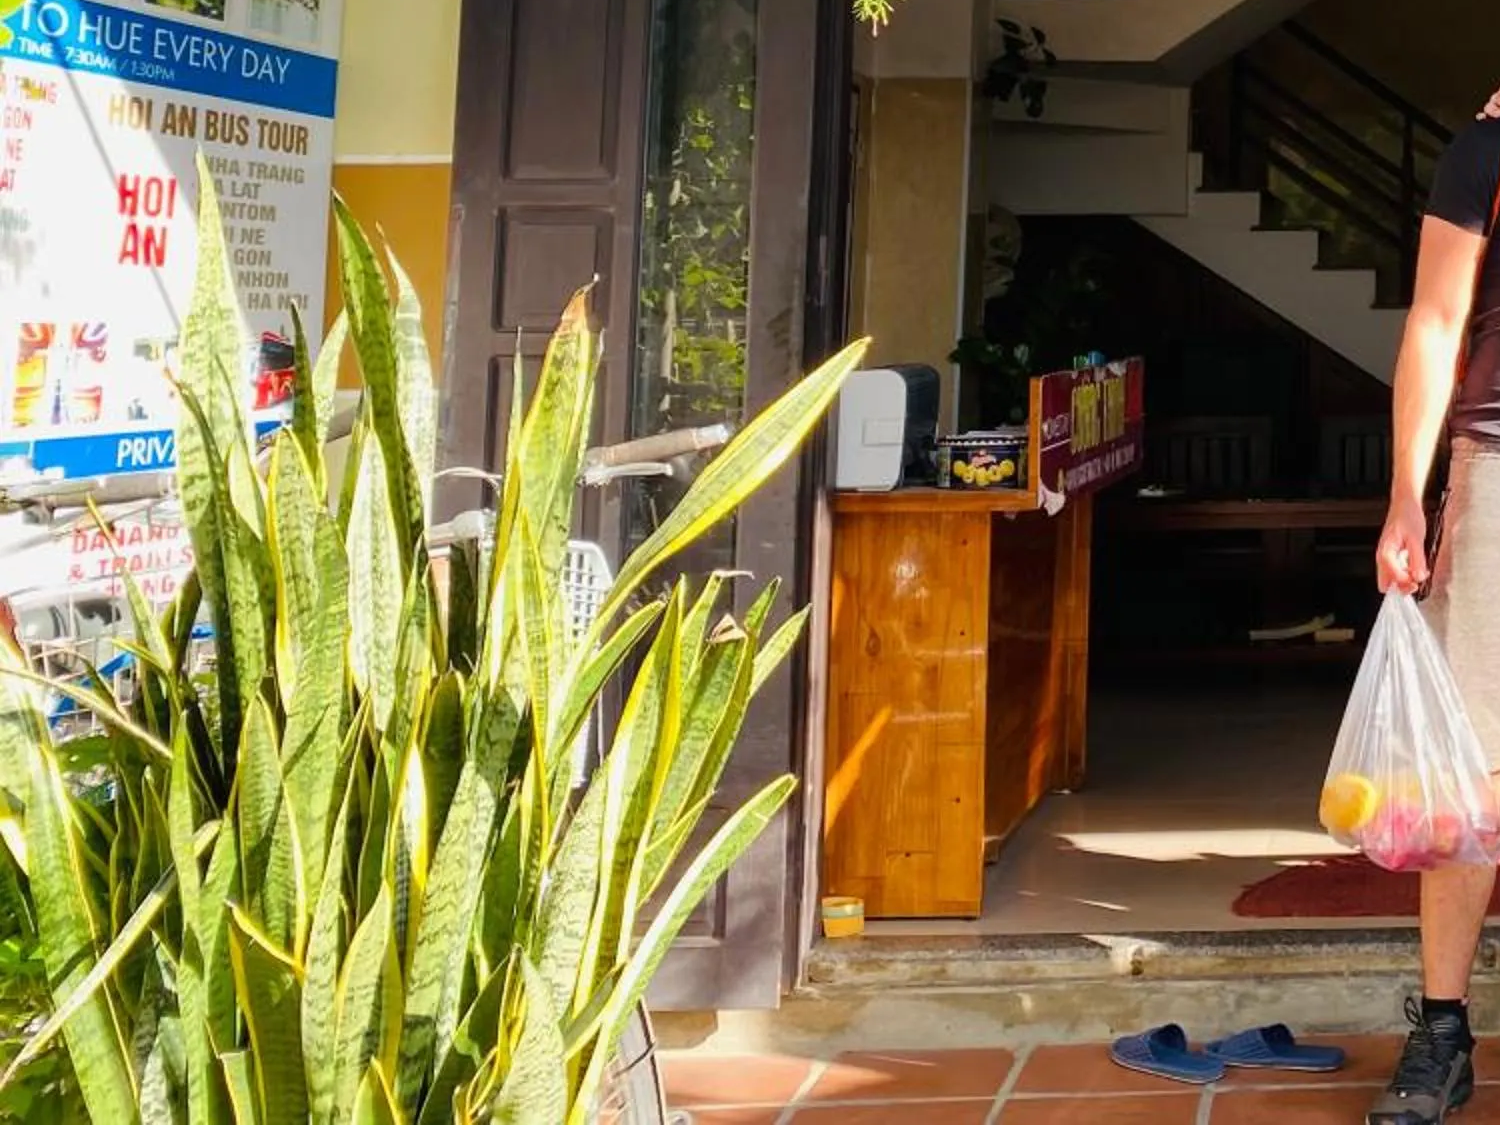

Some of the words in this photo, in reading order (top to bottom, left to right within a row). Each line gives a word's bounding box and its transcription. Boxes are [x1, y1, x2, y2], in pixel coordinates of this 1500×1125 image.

[18, 36, 55, 59] TIME
[77, 9, 144, 55] HUE
[153, 28, 235, 74] EVERY
[241, 47, 291, 86] DAY
[108, 94, 153, 132] HOI
[160, 102, 197, 139] AN
[204, 109, 250, 148] BUS
[256, 118, 309, 156] TOUR
[247, 161, 305, 185] TRANG
[117, 172, 178, 220] HOI
[231, 181, 262, 200] LAT
[118, 221, 168, 268] AN
[240, 228, 267, 246] NE
[247, 291, 272, 311] HA
